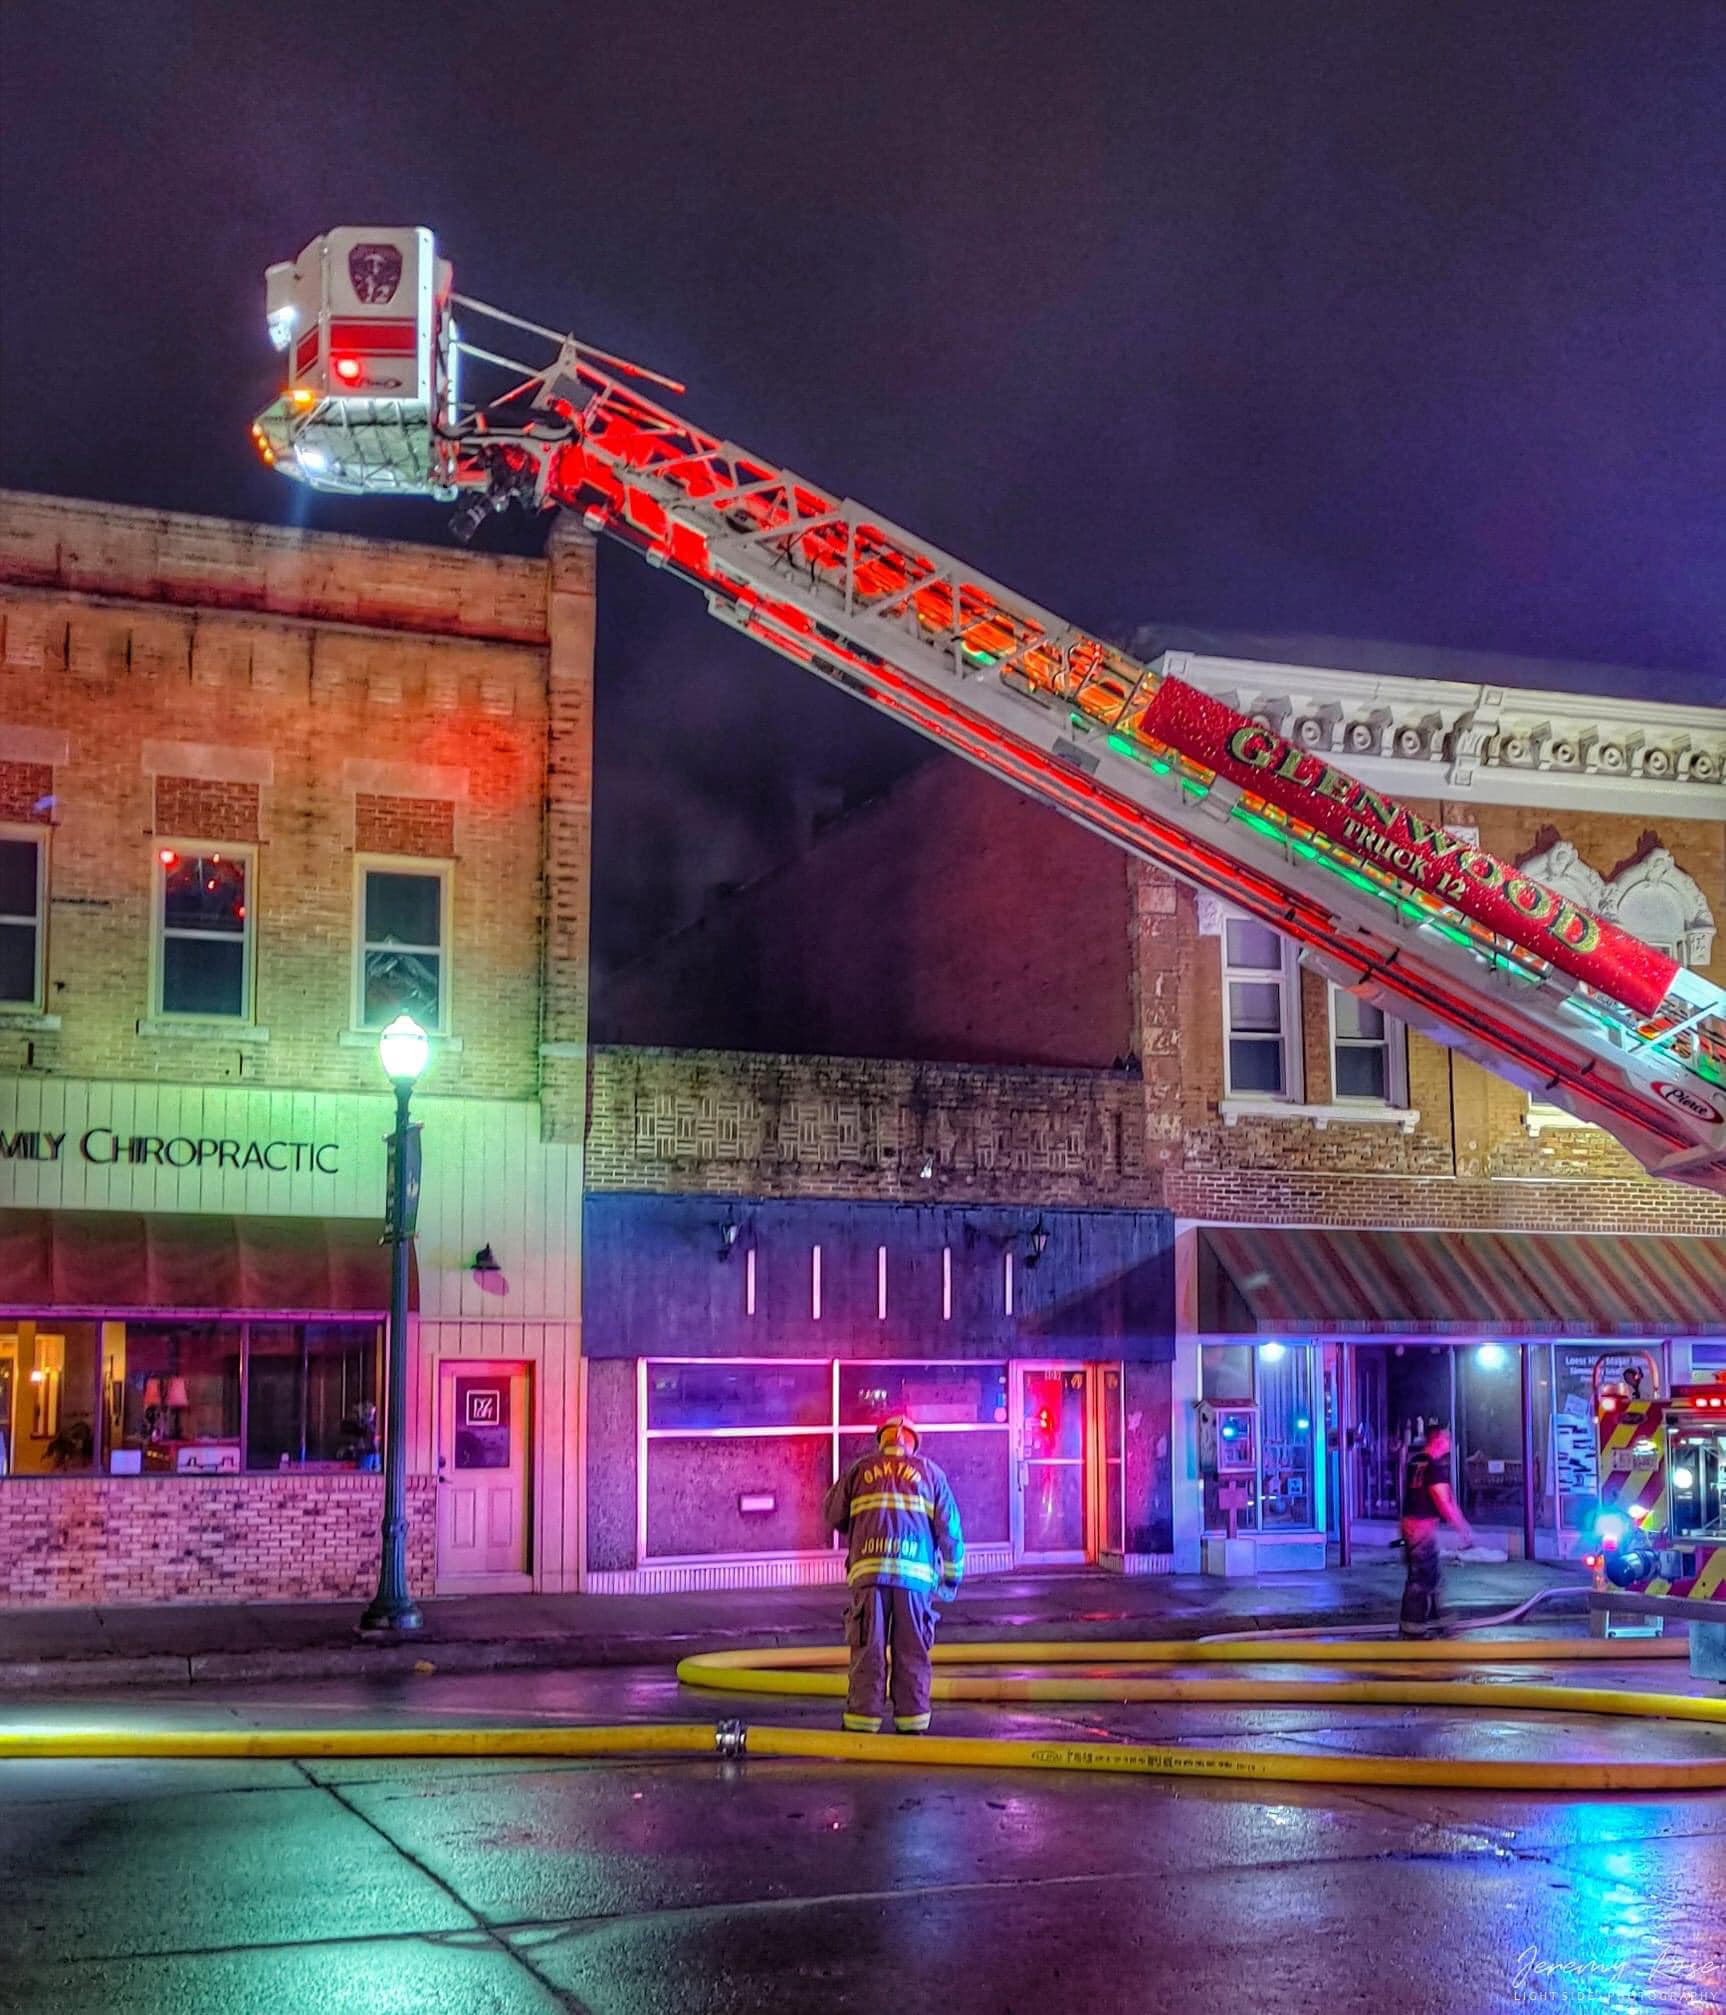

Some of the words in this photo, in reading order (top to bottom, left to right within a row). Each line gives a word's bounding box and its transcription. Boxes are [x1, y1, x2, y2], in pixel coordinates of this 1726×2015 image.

[1225, 727, 1601, 954] GLENWOOD
[1343, 817, 1427, 882] TRUCK
[1436, 871, 1466, 901] 12
[1665, 1087, 1709, 1116] Pierce
[80, 1128, 340, 1174] CHIROPRACTIC
[863, 1462, 893, 1484] OAK
